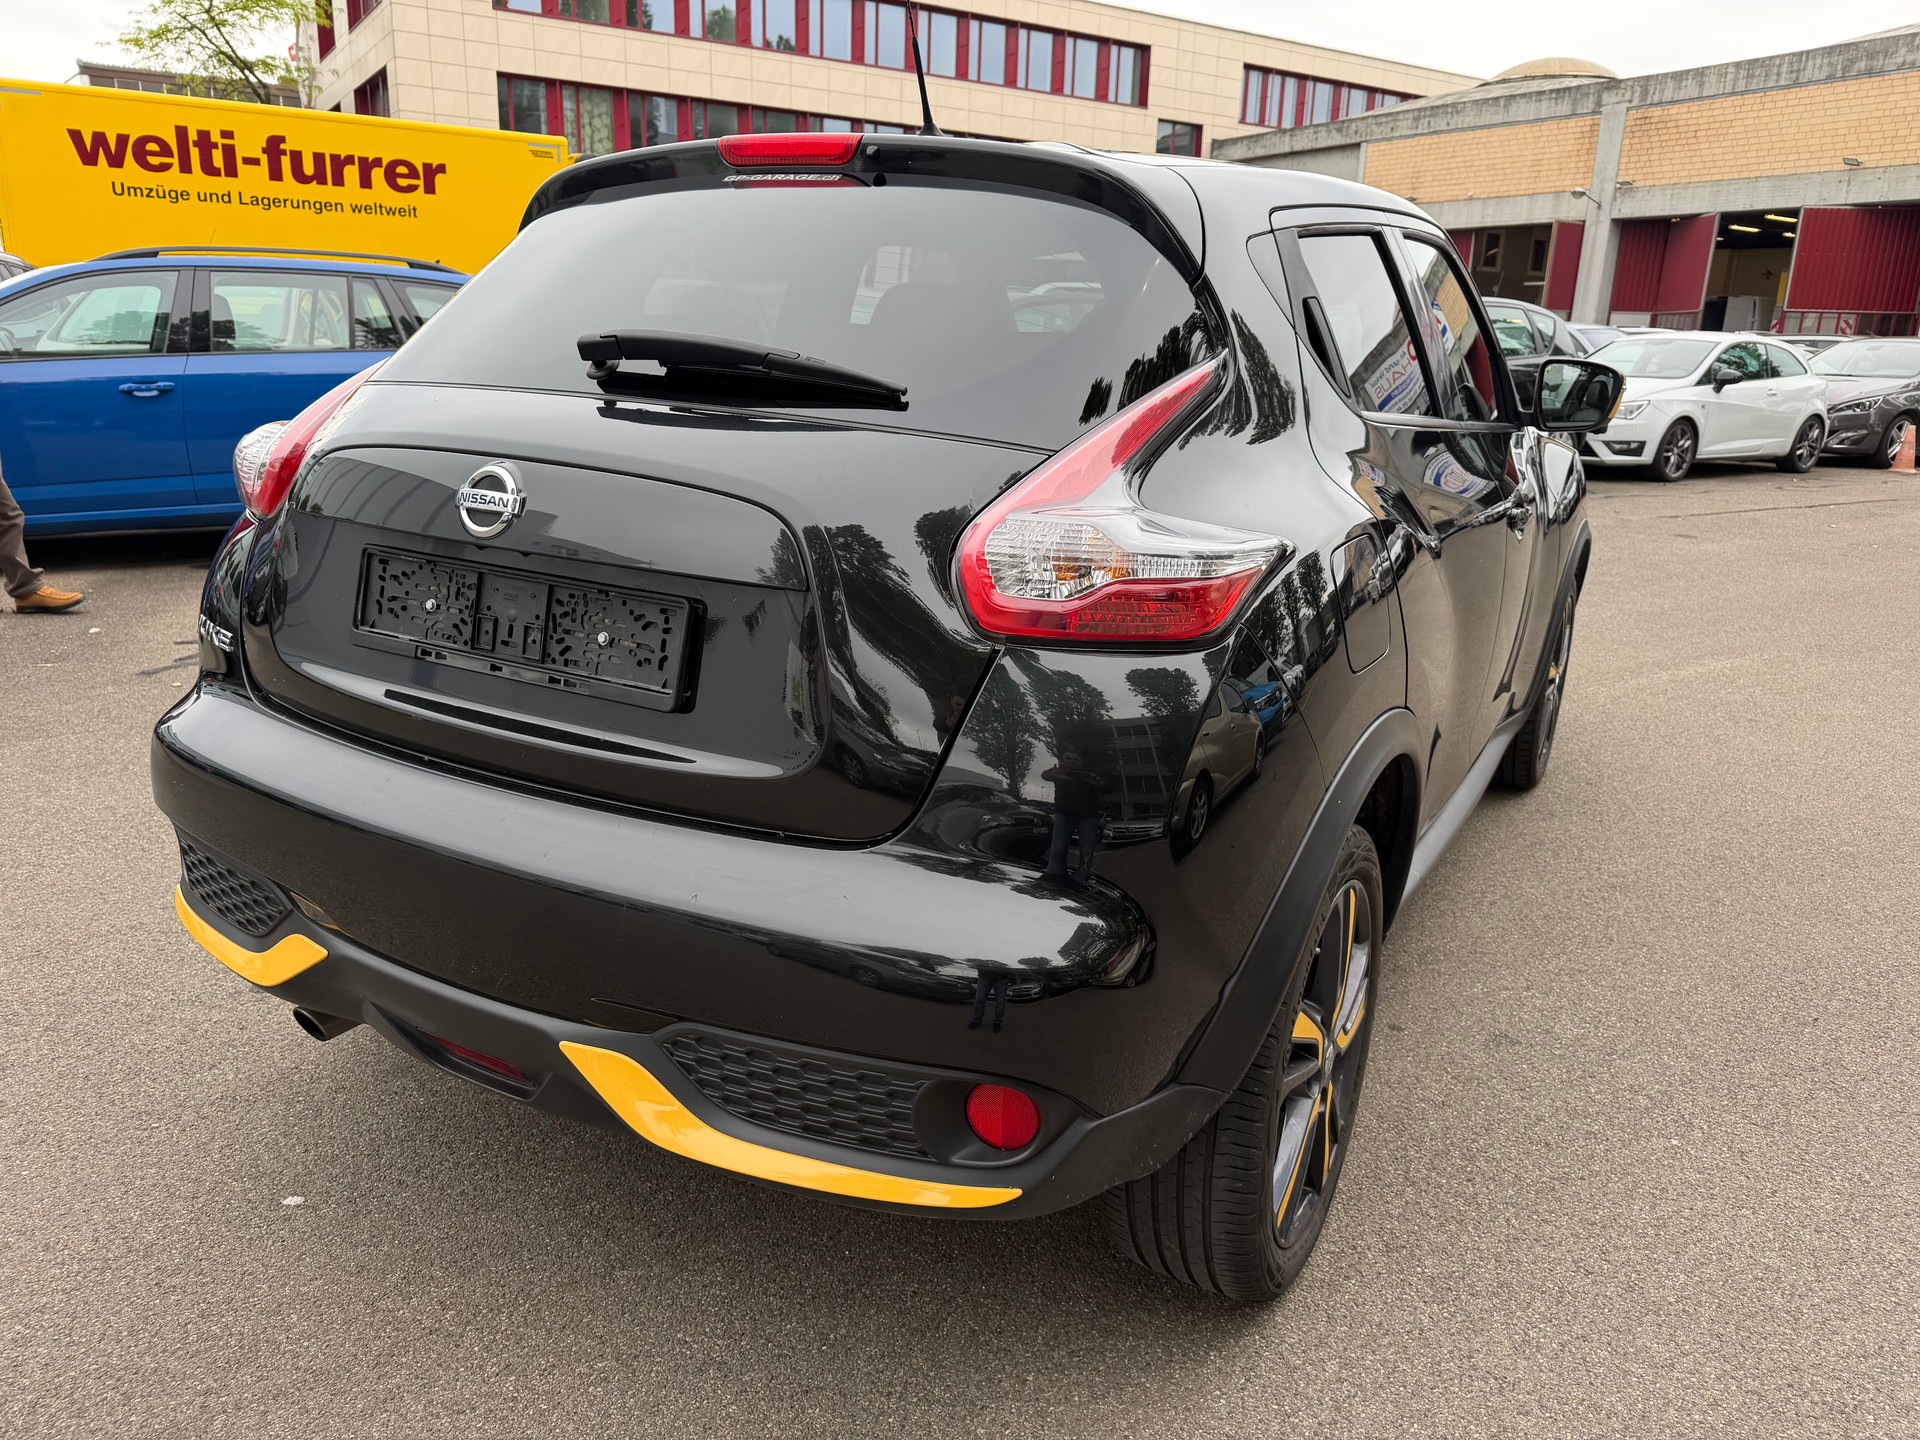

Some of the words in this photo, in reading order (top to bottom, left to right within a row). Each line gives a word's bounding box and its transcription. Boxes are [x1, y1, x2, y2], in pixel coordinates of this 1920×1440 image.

[66, 125, 447, 195] welti-furrer
[111, 181, 191, 204] Umzüge
[197, 190, 232, 204] und
[238, 191, 345, 215] Lagerungen
[350, 201, 419, 218] weltweit
[460, 491, 510, 509] NISSAN
[200, 613, 234, 652] UKE
